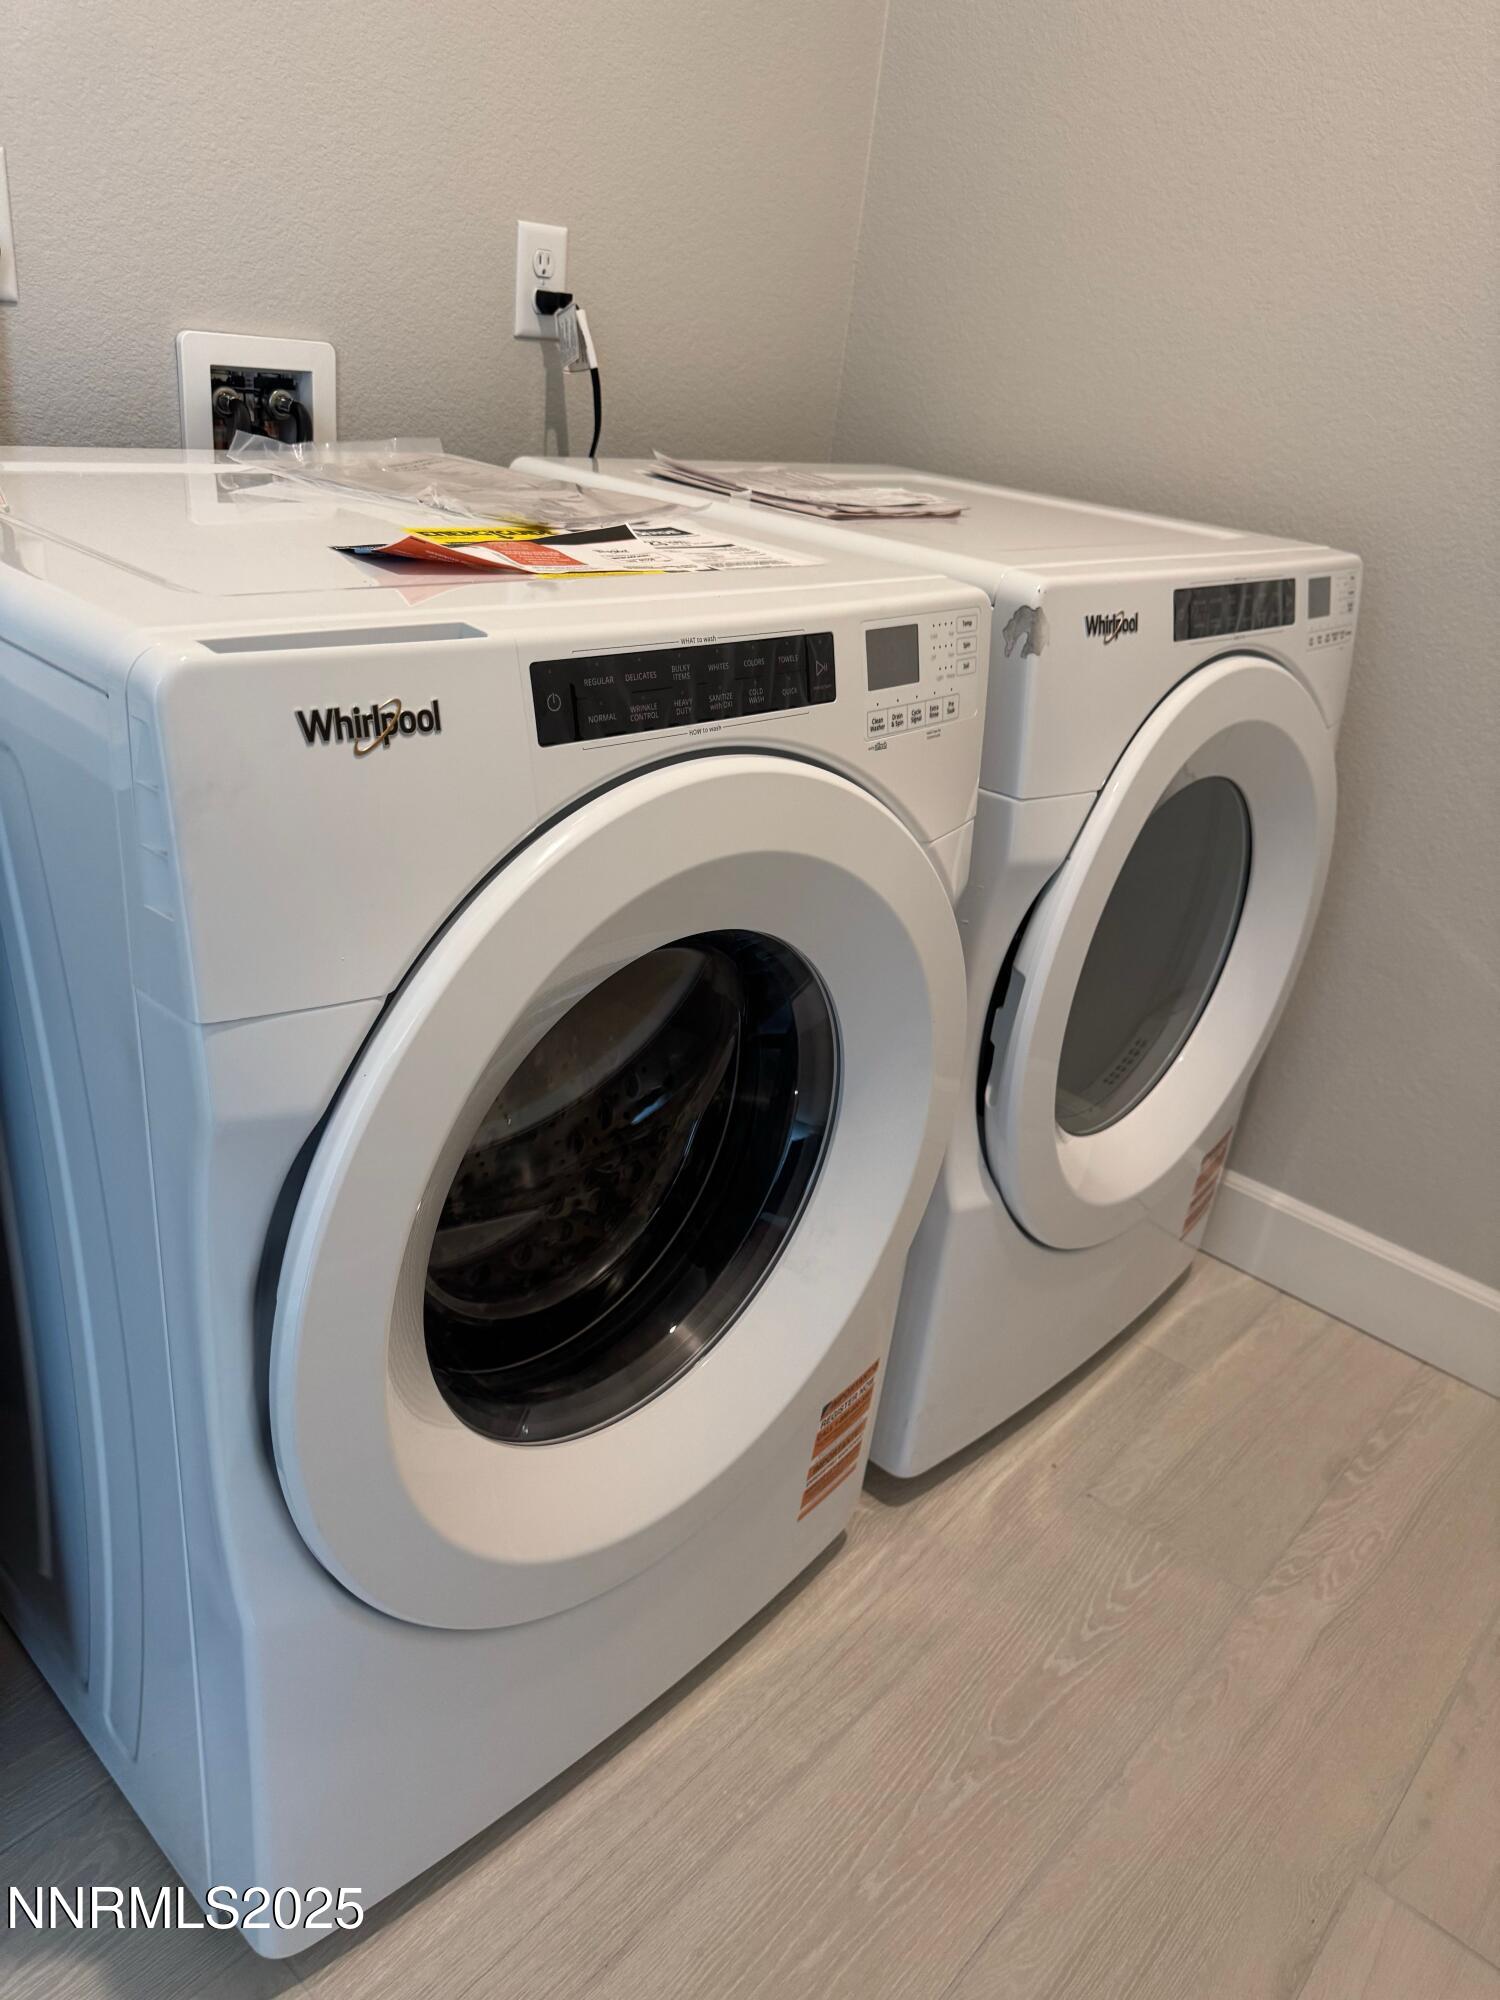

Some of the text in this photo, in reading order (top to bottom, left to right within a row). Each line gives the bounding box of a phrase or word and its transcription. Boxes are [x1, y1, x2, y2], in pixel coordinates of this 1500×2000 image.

[1085, 611, 1139, 642] Whirlpool
[680, 635, 717, 645] WHAT to wash
[744, 657, 765, 667] COLORS
[778, 654, 798, 664] TOWELS
[671, 663, 690, 673] BULKY
[708, 662, 729, 671] WHITES
[584, 675, 614, 687] REGULAR
[625, 671, 657, 682] DELICATES
[673, 672, 691, 681] ITEMS
[709, 691, 733, 701] SANITIZE
[748, 688, 764, 696] COLD
[782, 687, 798, 697] QUICK
[674, 698, 693, 707] HEAVY
[749, 696, 765, 704] WASH
[630, 702, 658, 713] WRINKLE
[676, 706, 692, 716] DUTY
[710, 702, 722, 711] with
[588, 713, 616, 724] NORMAL
[630, 711, 659, 722] CONTROL
[872, 717, 884, 725] Clean
[892, 713, 904, 721] Drain
[295, 699, 442, 750] Whirlpool
[689, 725, 722, 737] HOW to wash
